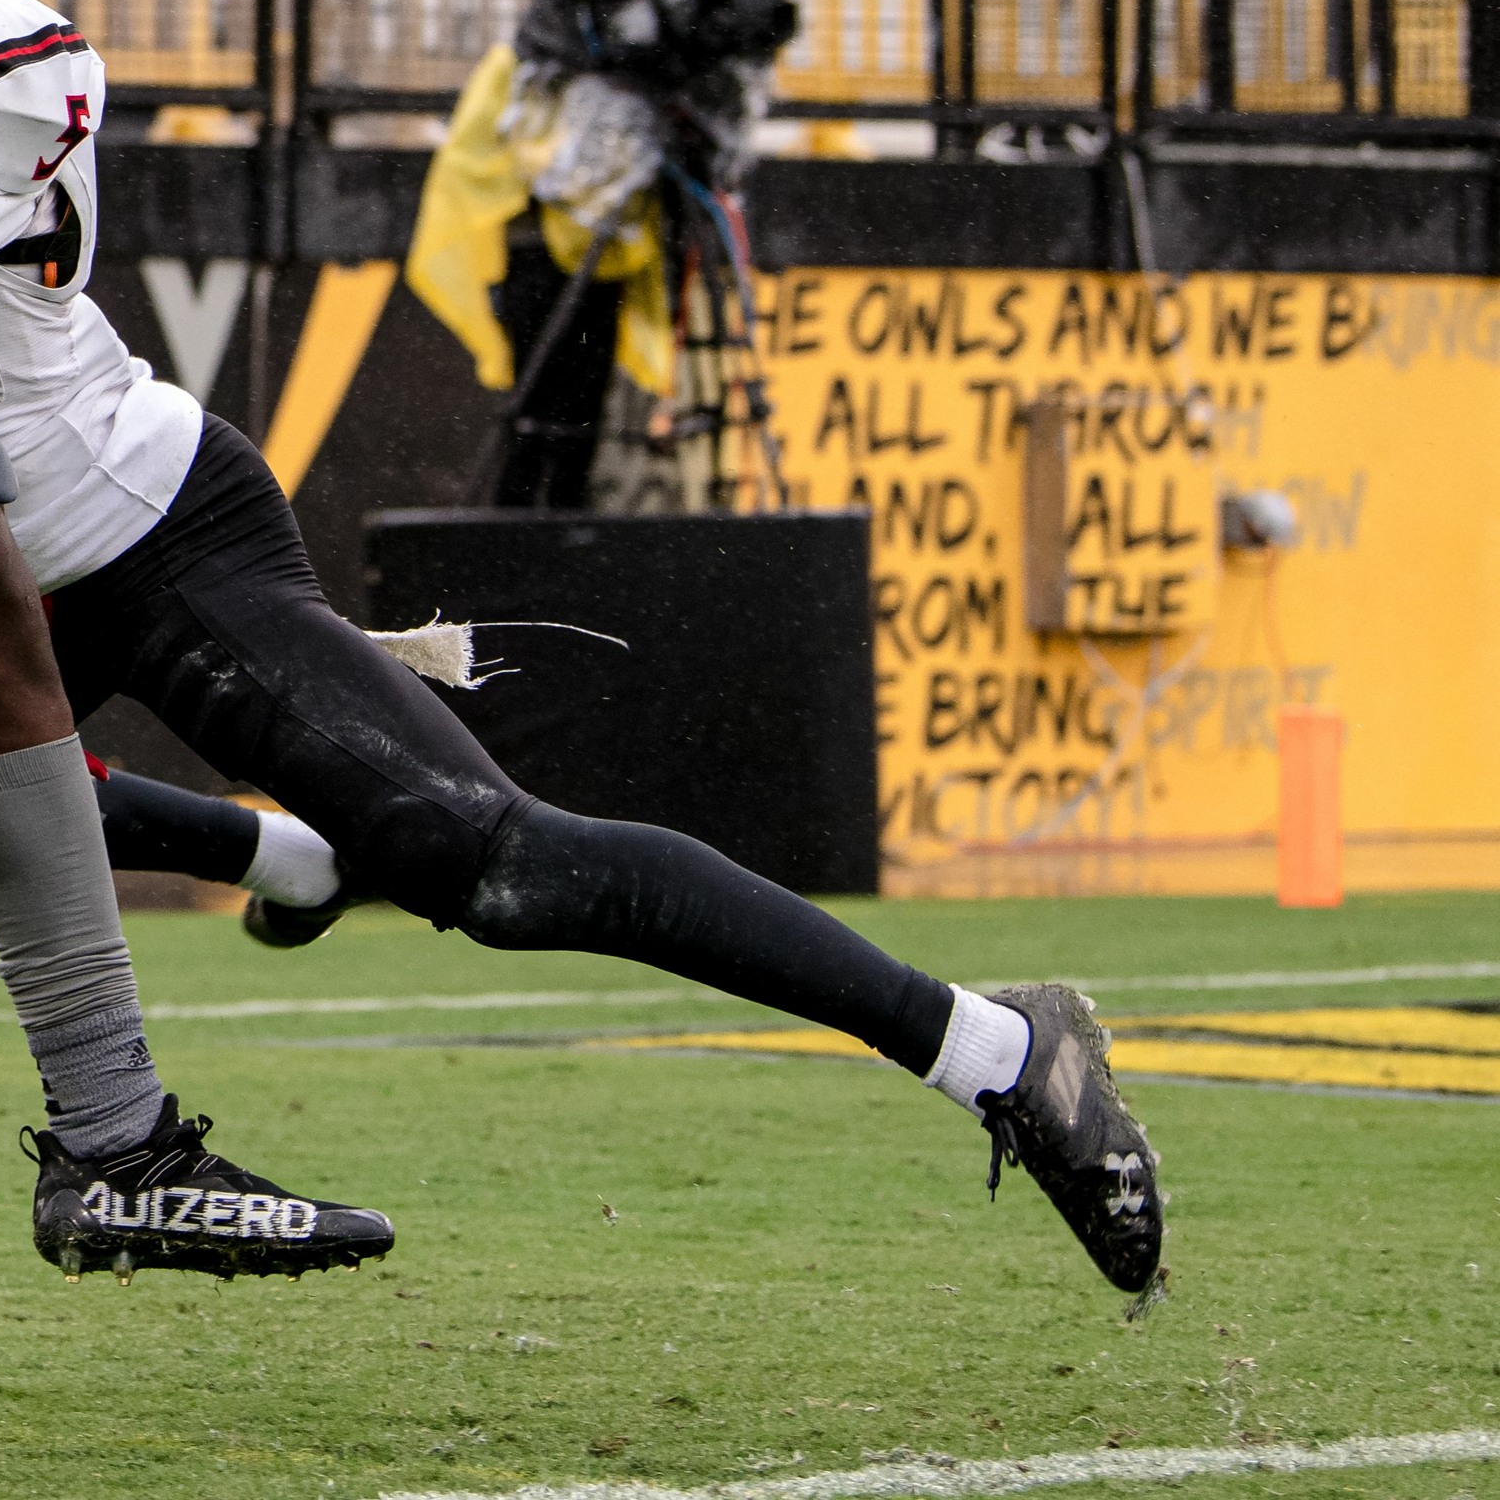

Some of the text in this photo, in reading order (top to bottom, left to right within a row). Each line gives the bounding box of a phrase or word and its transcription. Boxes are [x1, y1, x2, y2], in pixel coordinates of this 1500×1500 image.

[755, 279, 824, 354] HE
[849, 278, 1026, 357] OWLS
[1049, 282, 1191, 366] AND
[1210, 279, 1298, 359] WE
[815, 376, 947, 456] ALL
[1066, 474, 1198, 555] ALL
[875, 575, 1005, 663] ROM
